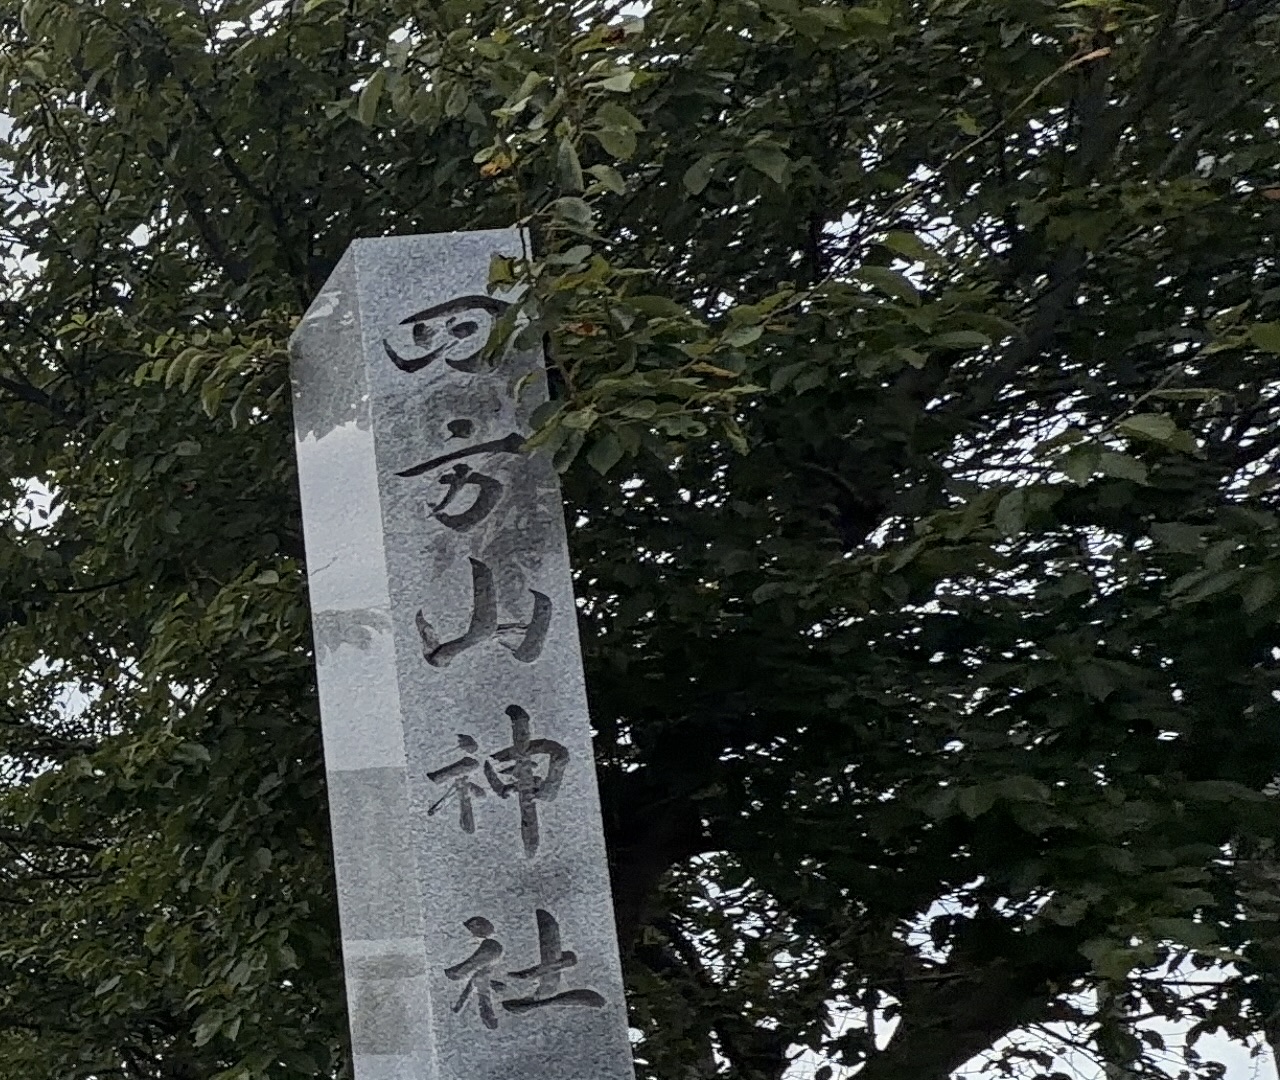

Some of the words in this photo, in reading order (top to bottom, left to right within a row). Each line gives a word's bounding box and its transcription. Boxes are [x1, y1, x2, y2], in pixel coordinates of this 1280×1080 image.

[382, 294, 606, 1030] 四方山神社
